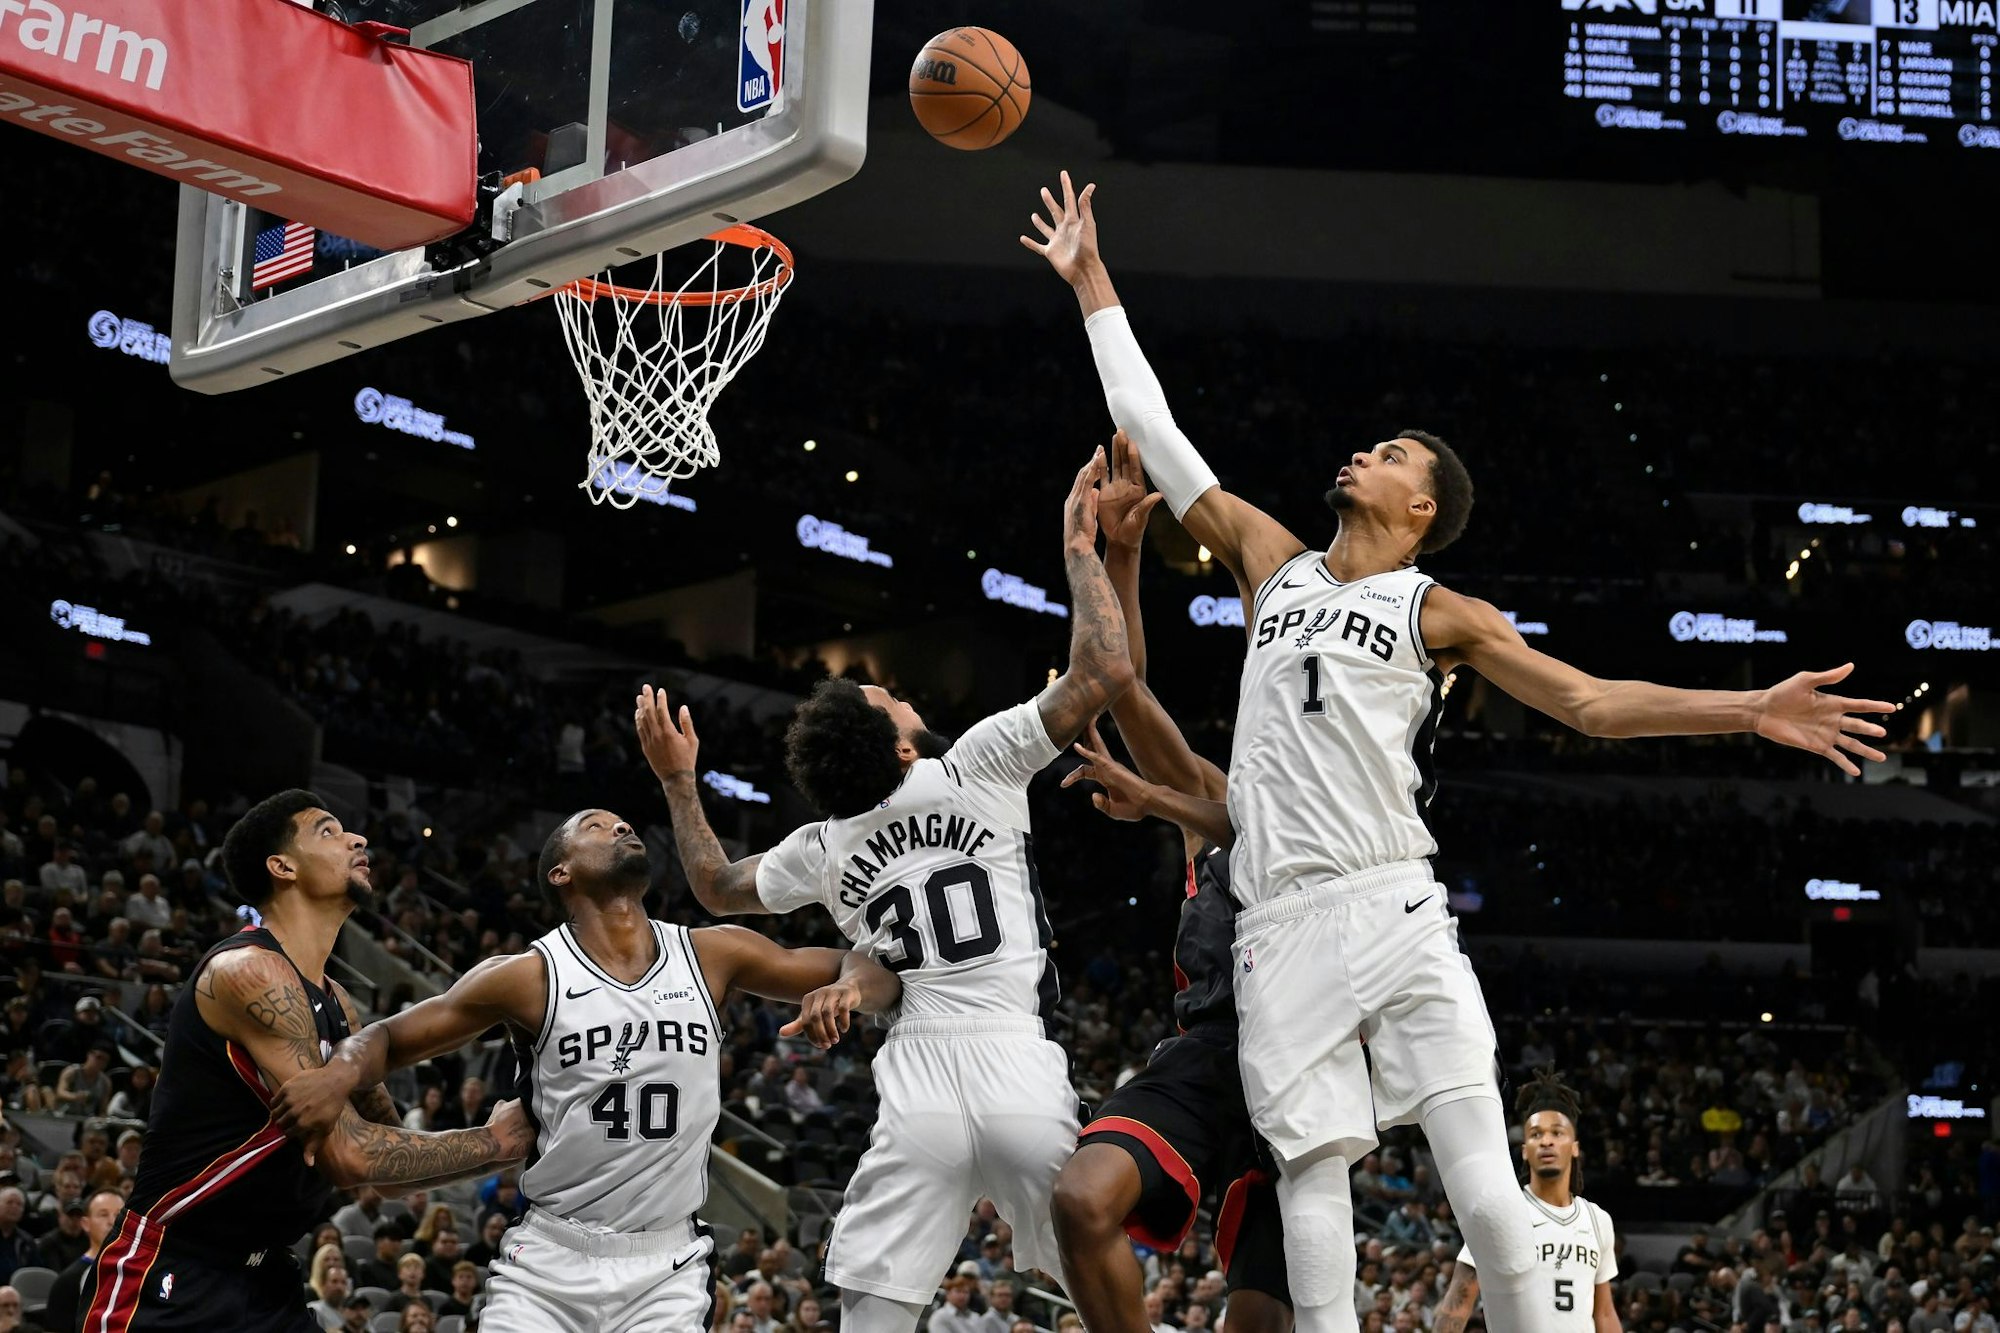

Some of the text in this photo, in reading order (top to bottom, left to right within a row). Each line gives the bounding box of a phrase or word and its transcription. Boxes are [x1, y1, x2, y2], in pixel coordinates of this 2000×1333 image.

[1940, 0, 1996, 28] MIA
[744, 75, 765, 103] NBA
[90, 130, 283, 197] Farm
[1366, 591, 1397, 605] LEDGER
[1256, 608, 1397, 662] SPURS
[1301, 654, 1325, 716] 1
[840, 813, 995, 909] CHAMPAGNIE
[862, 857, 1007, 972] 30
[658, 991, 690, 1001] LEDGER
[558, 1021, 708, 1076] SPURS
[589, 1081, 682, 1142] 40
[1536, 1243, 1600, 1271] PURS
[1554, 1280, 1575, 1313] 5
